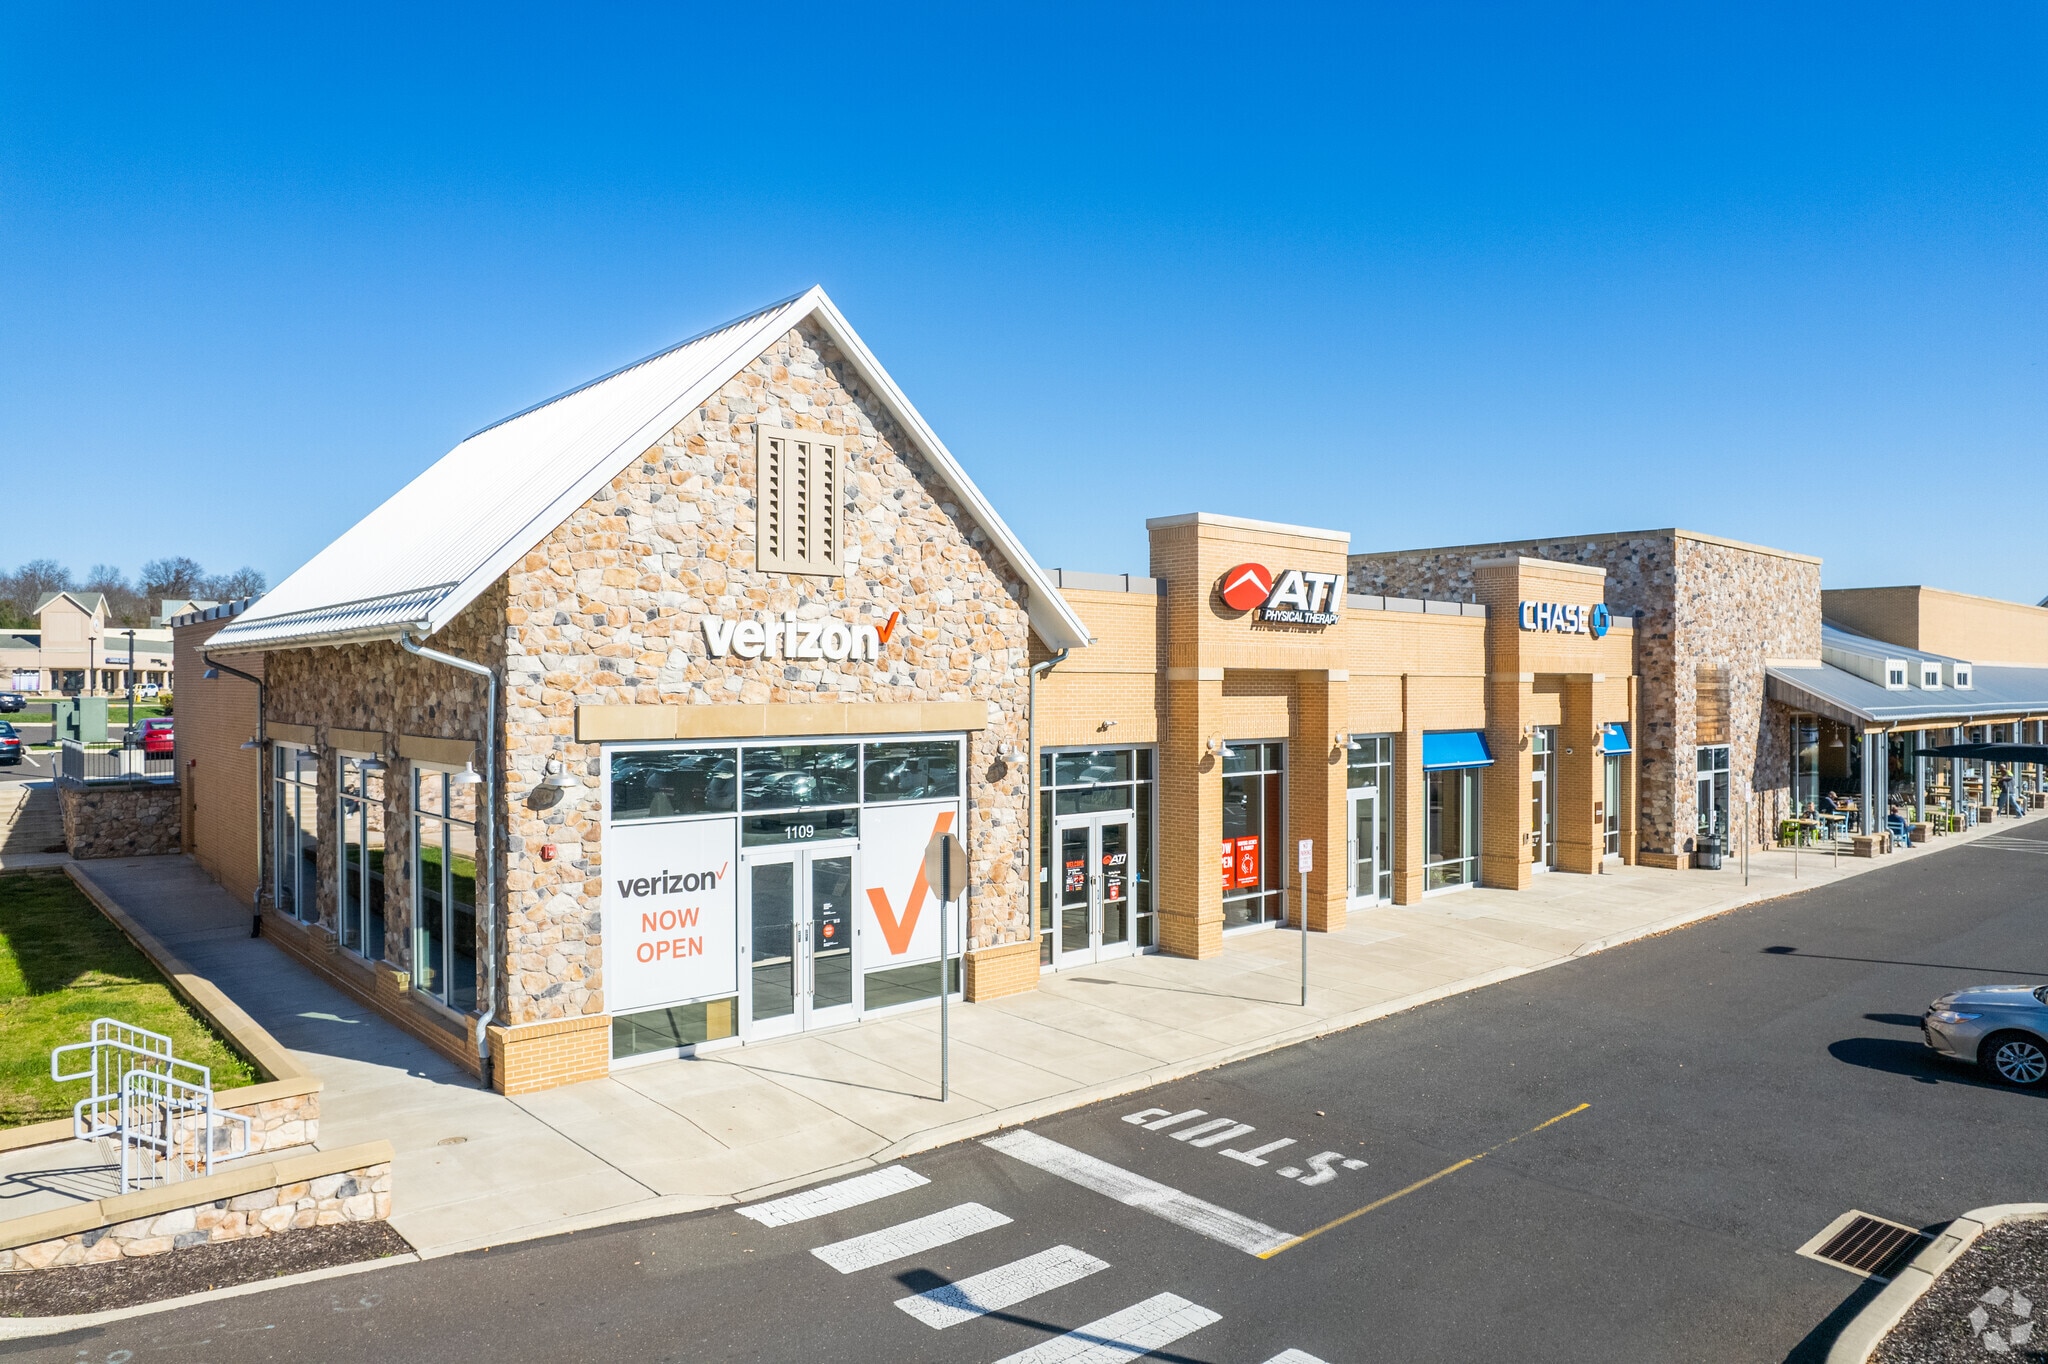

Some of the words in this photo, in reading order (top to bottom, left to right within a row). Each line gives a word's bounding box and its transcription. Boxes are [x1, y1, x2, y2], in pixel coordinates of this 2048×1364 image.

[1267, 570, 1345, 612] ATI
[1264, 609, 1305, 623] PHYSICAL
[1304, 612, 1341, 625] THERAPY
[1520, 601, 1590, 633] CHASE
[702, 611, 879, 660] verizon
[785, 824, 814, 839] 1109
[1109, 854, 1127, 865] ATI
[618, 869, 716, 898] verizon
[641, 907, 700, 933] NOW
[636, 935, 703, 963] OPEN
[1121, 1108, 1368, 1186] STOP
